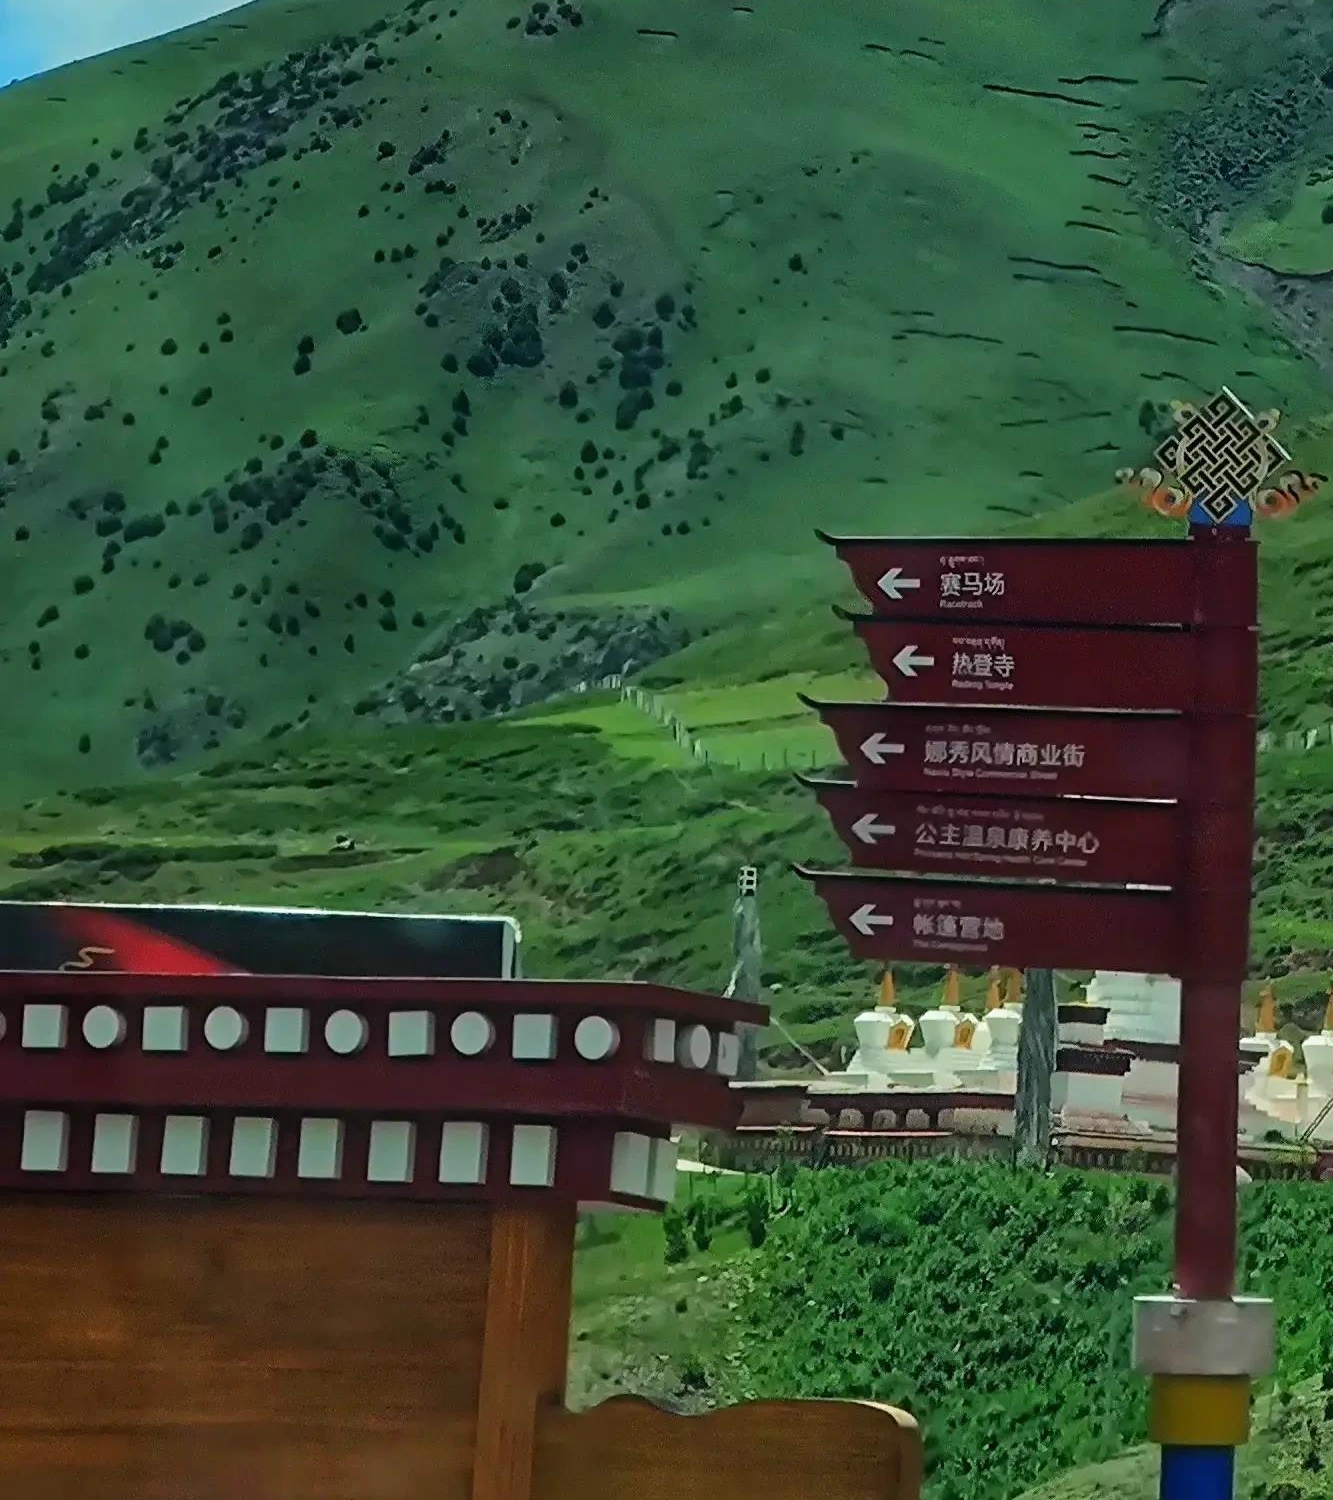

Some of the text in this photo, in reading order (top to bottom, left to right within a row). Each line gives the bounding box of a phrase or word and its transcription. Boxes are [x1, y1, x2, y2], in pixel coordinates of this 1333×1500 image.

[940, 572, 1005, 597] 赛马场
[952, 651, 1015, 678] 热登寺
